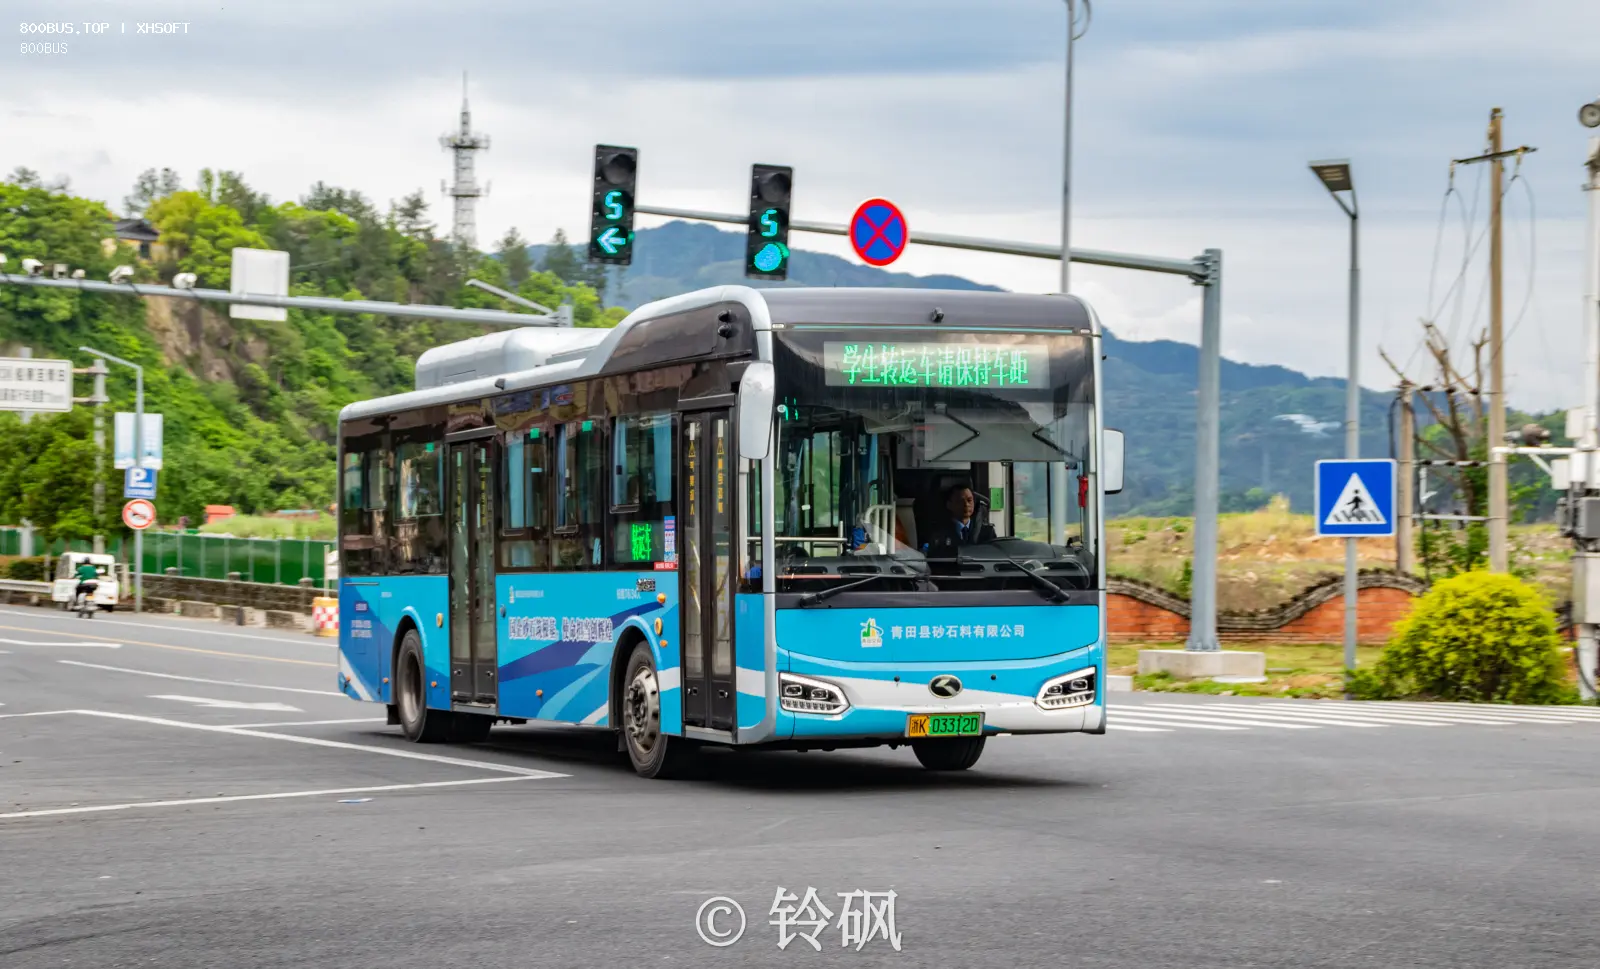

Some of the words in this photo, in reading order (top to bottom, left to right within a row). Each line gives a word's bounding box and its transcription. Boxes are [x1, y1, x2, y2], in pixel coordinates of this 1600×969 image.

[842, 344, 1029, 386] 学生转运车请保持车距
[891, 624, 1025, 640] 青田县砂石料有限公司
